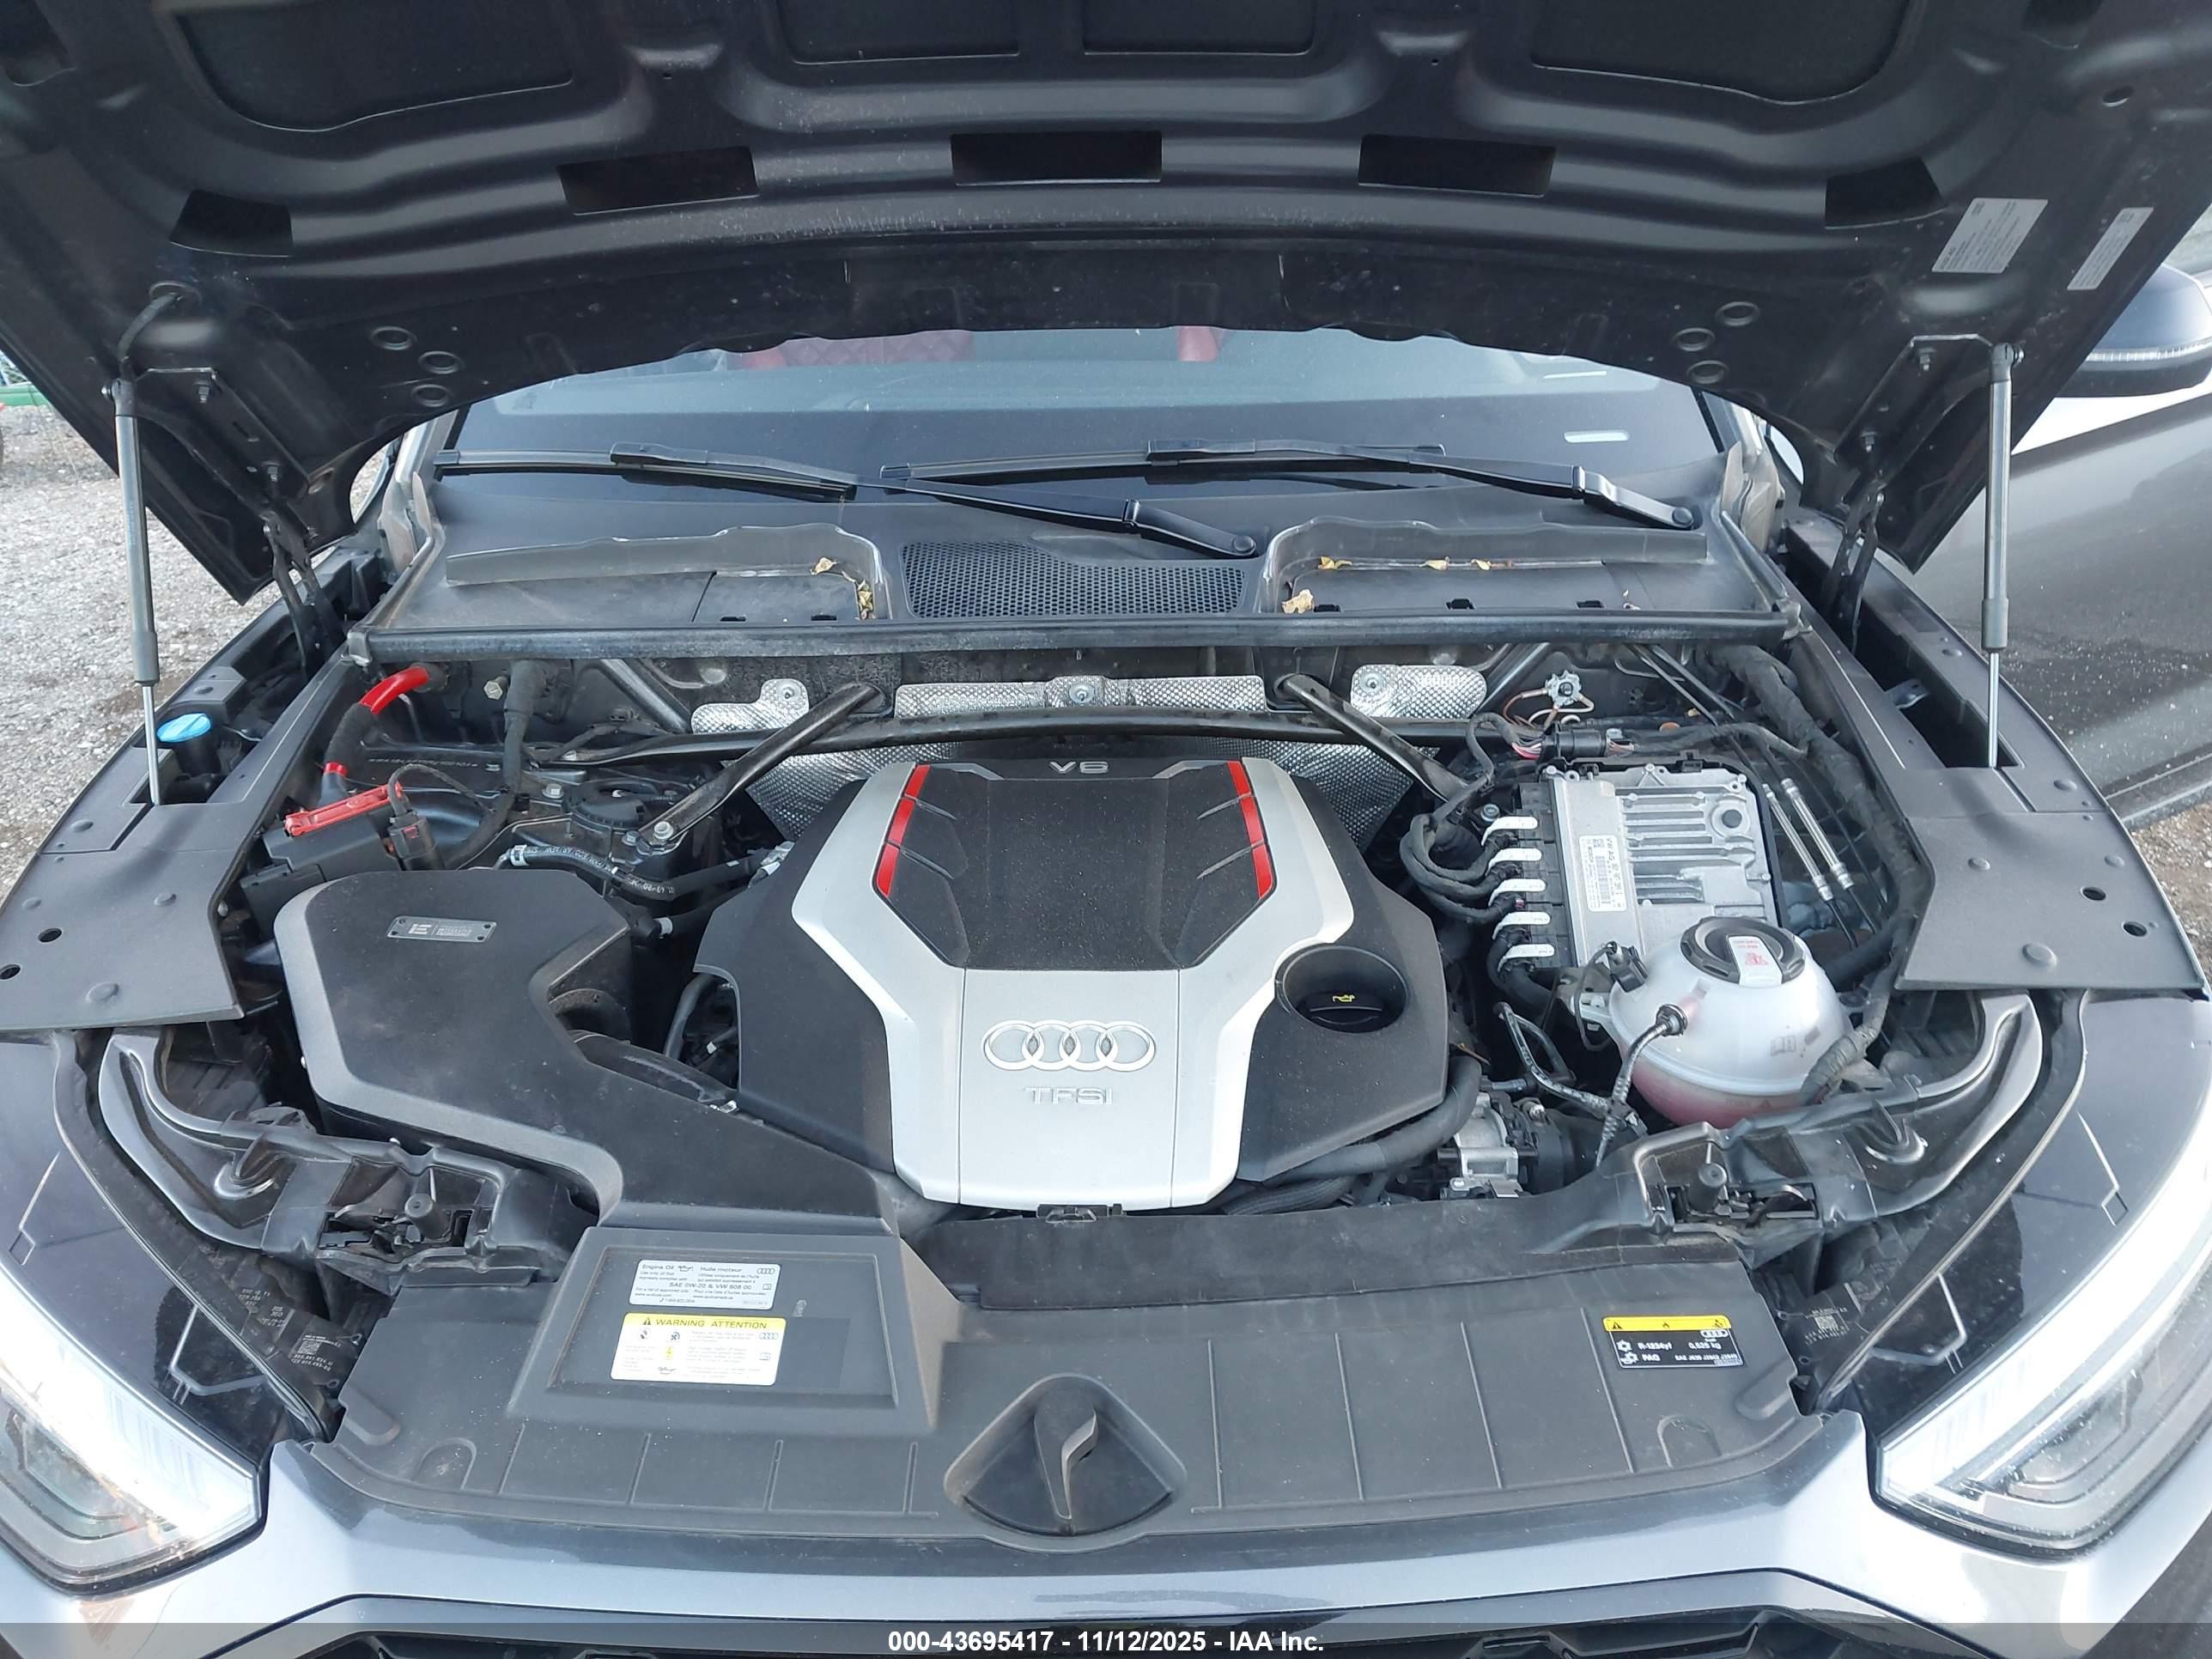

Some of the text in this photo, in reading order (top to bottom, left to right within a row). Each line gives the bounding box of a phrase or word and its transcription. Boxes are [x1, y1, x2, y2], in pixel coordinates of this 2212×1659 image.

[1048, 760, 1109, 775] V6
[1024, 1086, 1114, 1107] TFSI
[656, 1318, 768, 1329] WARNING ATTENTION
